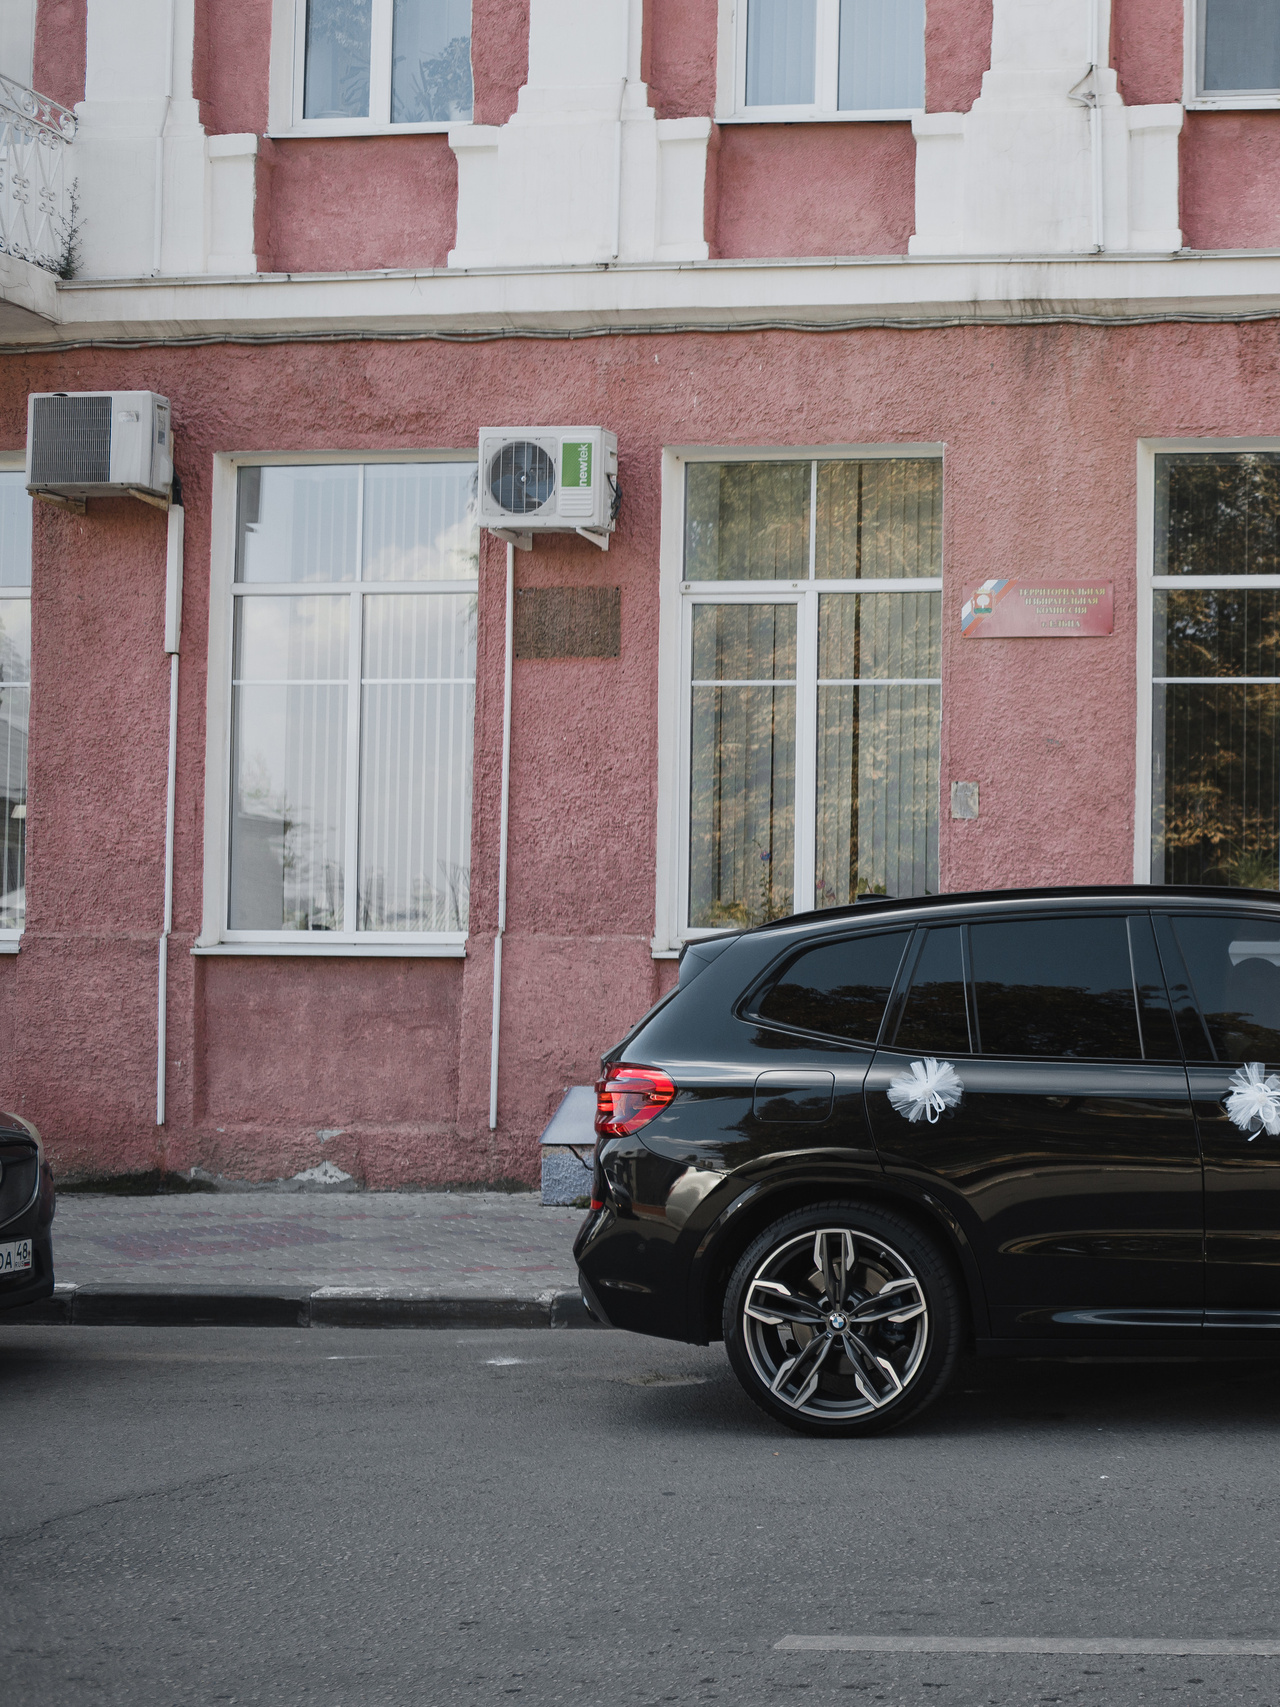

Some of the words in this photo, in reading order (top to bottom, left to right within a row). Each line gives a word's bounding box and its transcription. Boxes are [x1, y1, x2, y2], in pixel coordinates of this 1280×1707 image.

[578, 443, 589, 487] newtek
[1019, 588, 1106, 596] ТЕРРИТОРИАЛЬНАЯ
[1049, 619, 1081, 628] ЕЛЬЦА
[16, 1242, 28, 1261] 48
